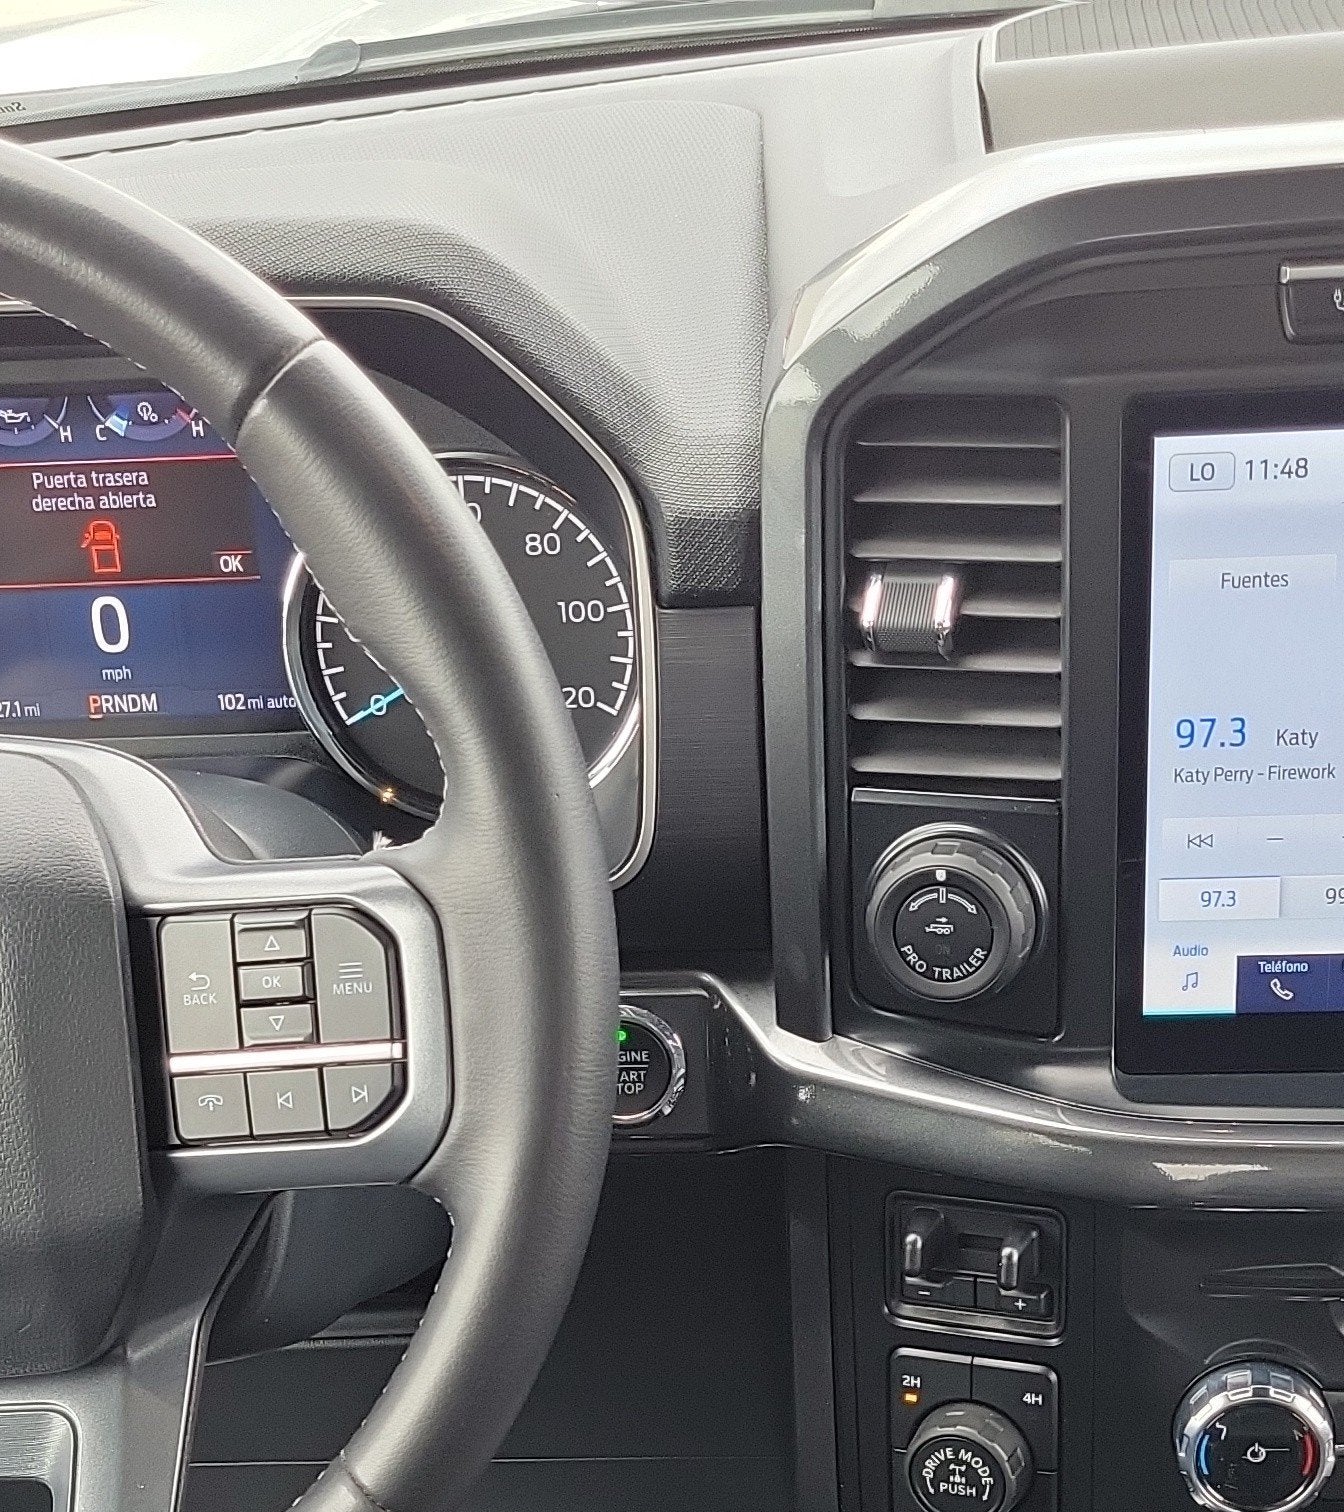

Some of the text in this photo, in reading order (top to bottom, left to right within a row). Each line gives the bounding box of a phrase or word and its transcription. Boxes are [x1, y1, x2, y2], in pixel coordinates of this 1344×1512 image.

[59, 426, 72, 443] H
[95, 425, 107, 442] C
[191, 420, 204, 438] H
[1188, 461, 1216, 483] LO
[1244, 456, 1310, 482] 11:48
[31, 469, 150, 491] Puerta trasera
[31, 490, 157, 513] derecha abierta
[524, 532, 561, 556] 80
[219, 555, 245, 574] OK
[1219, 569, 1290, 590] Fuentes
[557, 599, 605, 623] 100
[90, 595, 131, 655] 0
[101, 664, 133, 684] mph
[88, 692, 159, 714] PRNDM
[217, 693, 246, 711] 102
[369, 693, 388, 716] 0
[1175, 715, 1248, 750] 97.3
[1274, 726, 1320, 752] Katy
[1172, 765, 1211, 786] Katy
[1213, 764, 1255, 785] Perry
[1266, 761, 1338, 782] Firework
[1199, 889, 1238, 909] 97.3
[1172, 942, 1210, 958] Audio
[900, 944, 989, 981] PRO TRAILER
[1257, 957, 1310, 975] Teléfono
[262, 974, 283, 989] OK
[331, 981, 374, 996] MENU
[182, 992, 218, 1006] BACK
[617, 1050, 650, 1063] GINE
[619, 1070, 647, 1082] ART
[616, 1083, 645, 1095] TOP
[901, 1374, 922, 1389] 2H
[1021, 1391, 1044, 1407] 4H
[921, 1446, 995, 1487] DRIVE MODE
[939, 1481, 977, 1497] PUSH
